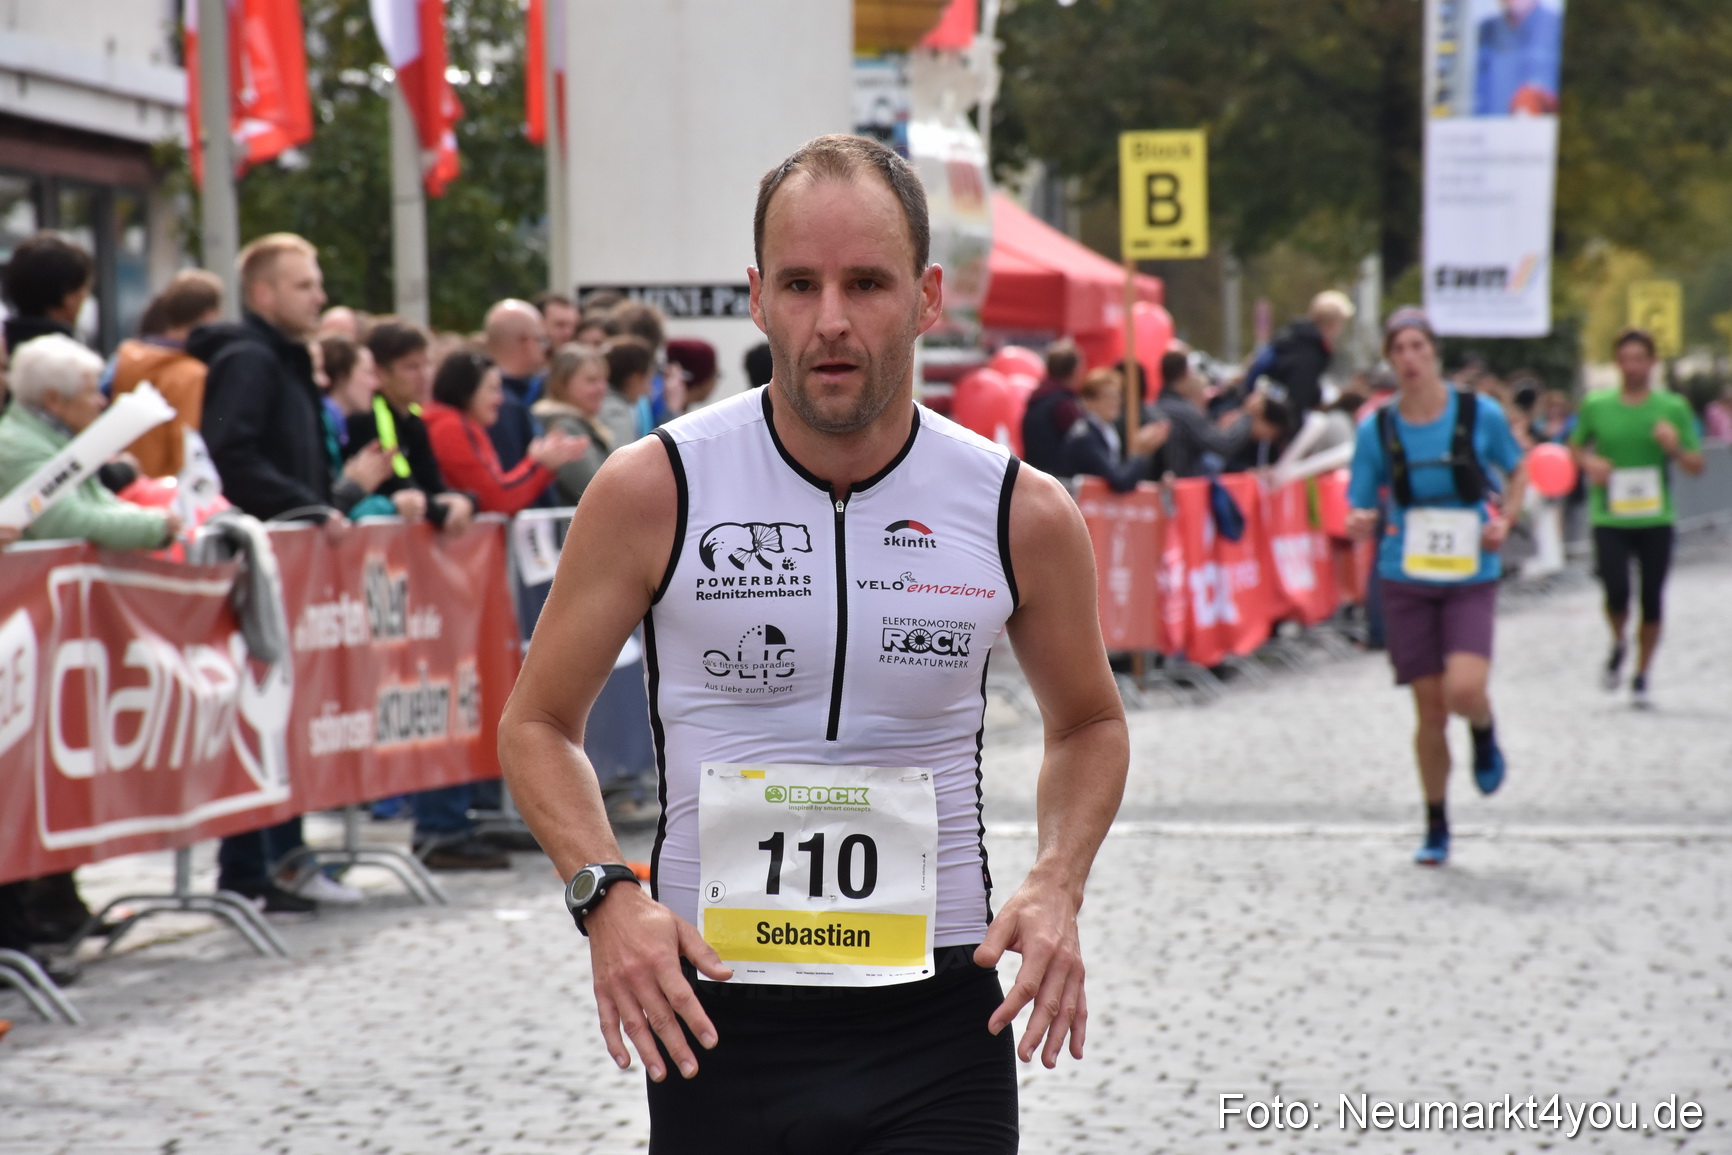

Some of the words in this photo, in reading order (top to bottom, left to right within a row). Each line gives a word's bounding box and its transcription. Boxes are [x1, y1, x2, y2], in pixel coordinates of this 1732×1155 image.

[1146, 173, 1183, 228] B
[883, 535, 937, 548] skinfit
[696, 574, 812, 588] POWERBÄRS
[696, 587, 812, 601] Rednitzhembach
[856, 580, 904, 591] VELO
[906, 583, 996, 599] emozione
[882, 616, 976, 630] ELEKTROMOTOREN
[882, 627, 971, 657] ROCK
[720, 660, 749, 670] fitness
[752, 661, 795, 671] paradies
[879, 654, 969, 668] REPARATURWERK
[704, 682, 718, 691] Aus
[721, 685, 743, 693] Liebe
[768, 684, 793, 695] Sport
[789, 786, 870, 805] BOCK
[758, 831, 878, 900] 110
[711, 887, 719, 898] B
[756, 921, 871, 948] Sebastian
